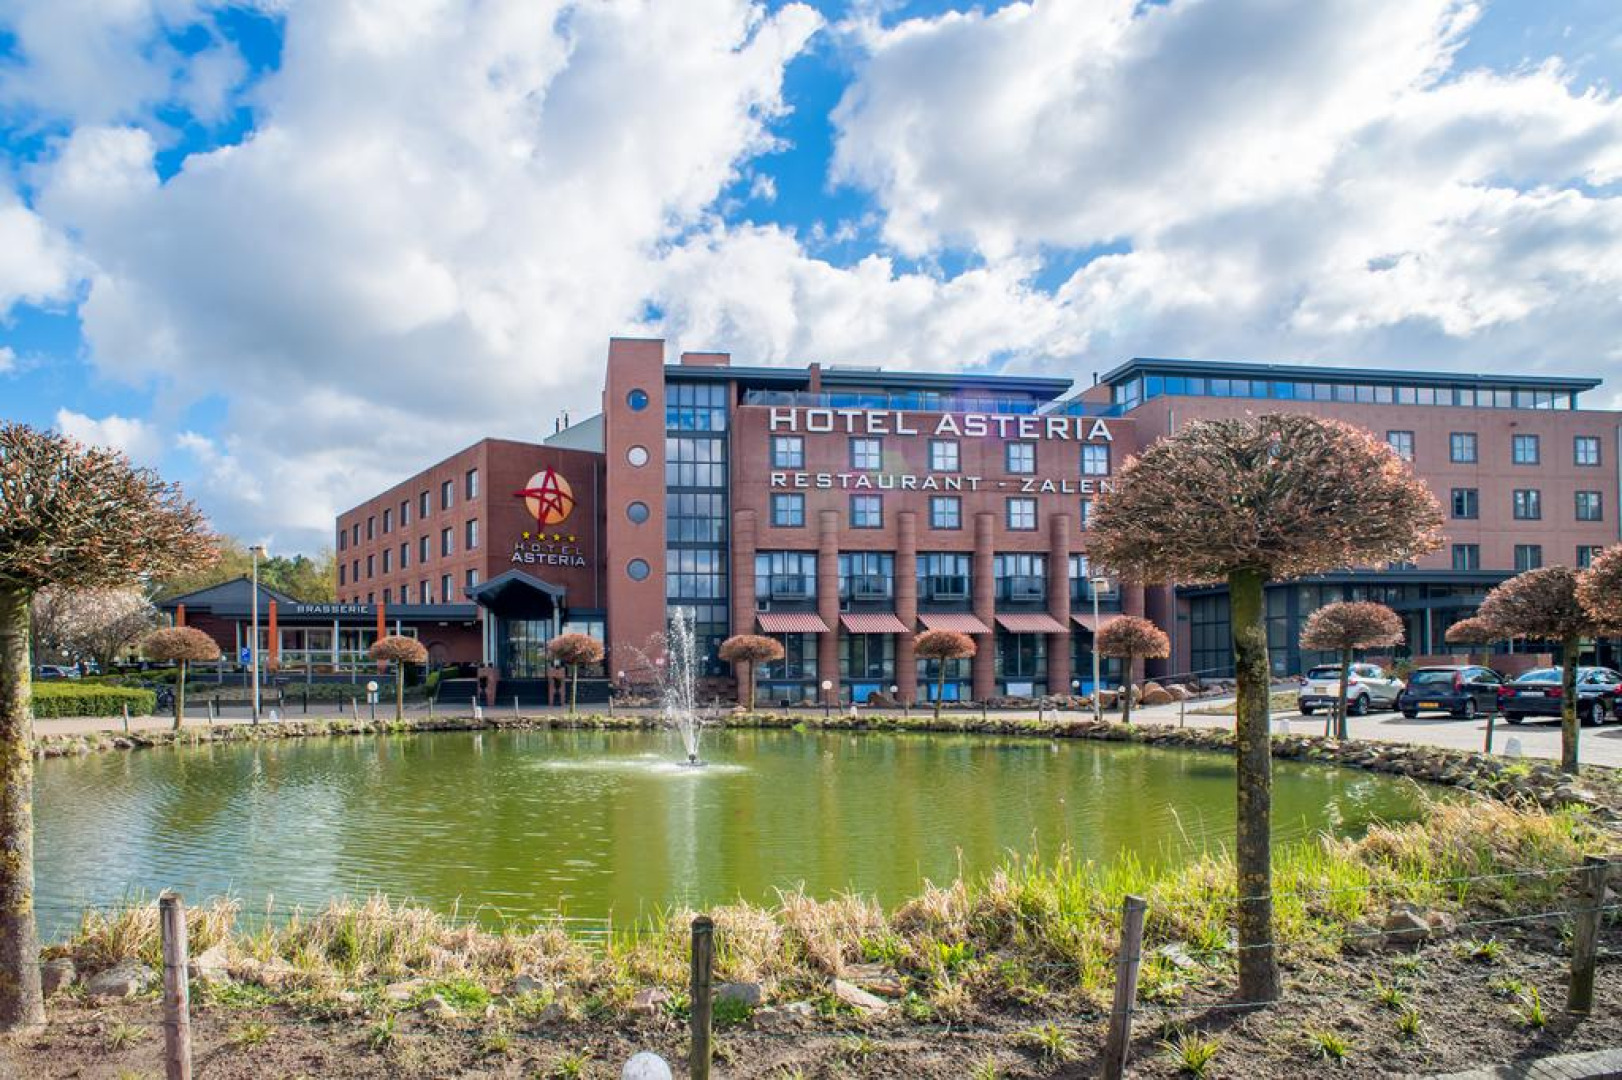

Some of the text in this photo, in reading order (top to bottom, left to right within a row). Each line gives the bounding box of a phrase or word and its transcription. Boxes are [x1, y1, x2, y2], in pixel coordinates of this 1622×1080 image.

[769, 407, 1114, 441] HOTEL ASTERIA
[770, 472, 983, 492] RESTAURANT
[1021, 477, 1116, 494] ZALEN
[514, 542, 583, 555] HOTEL
[511, 552, 586, 567] ASTERIA
[297, 604, 369, 614] BRASSERIE
